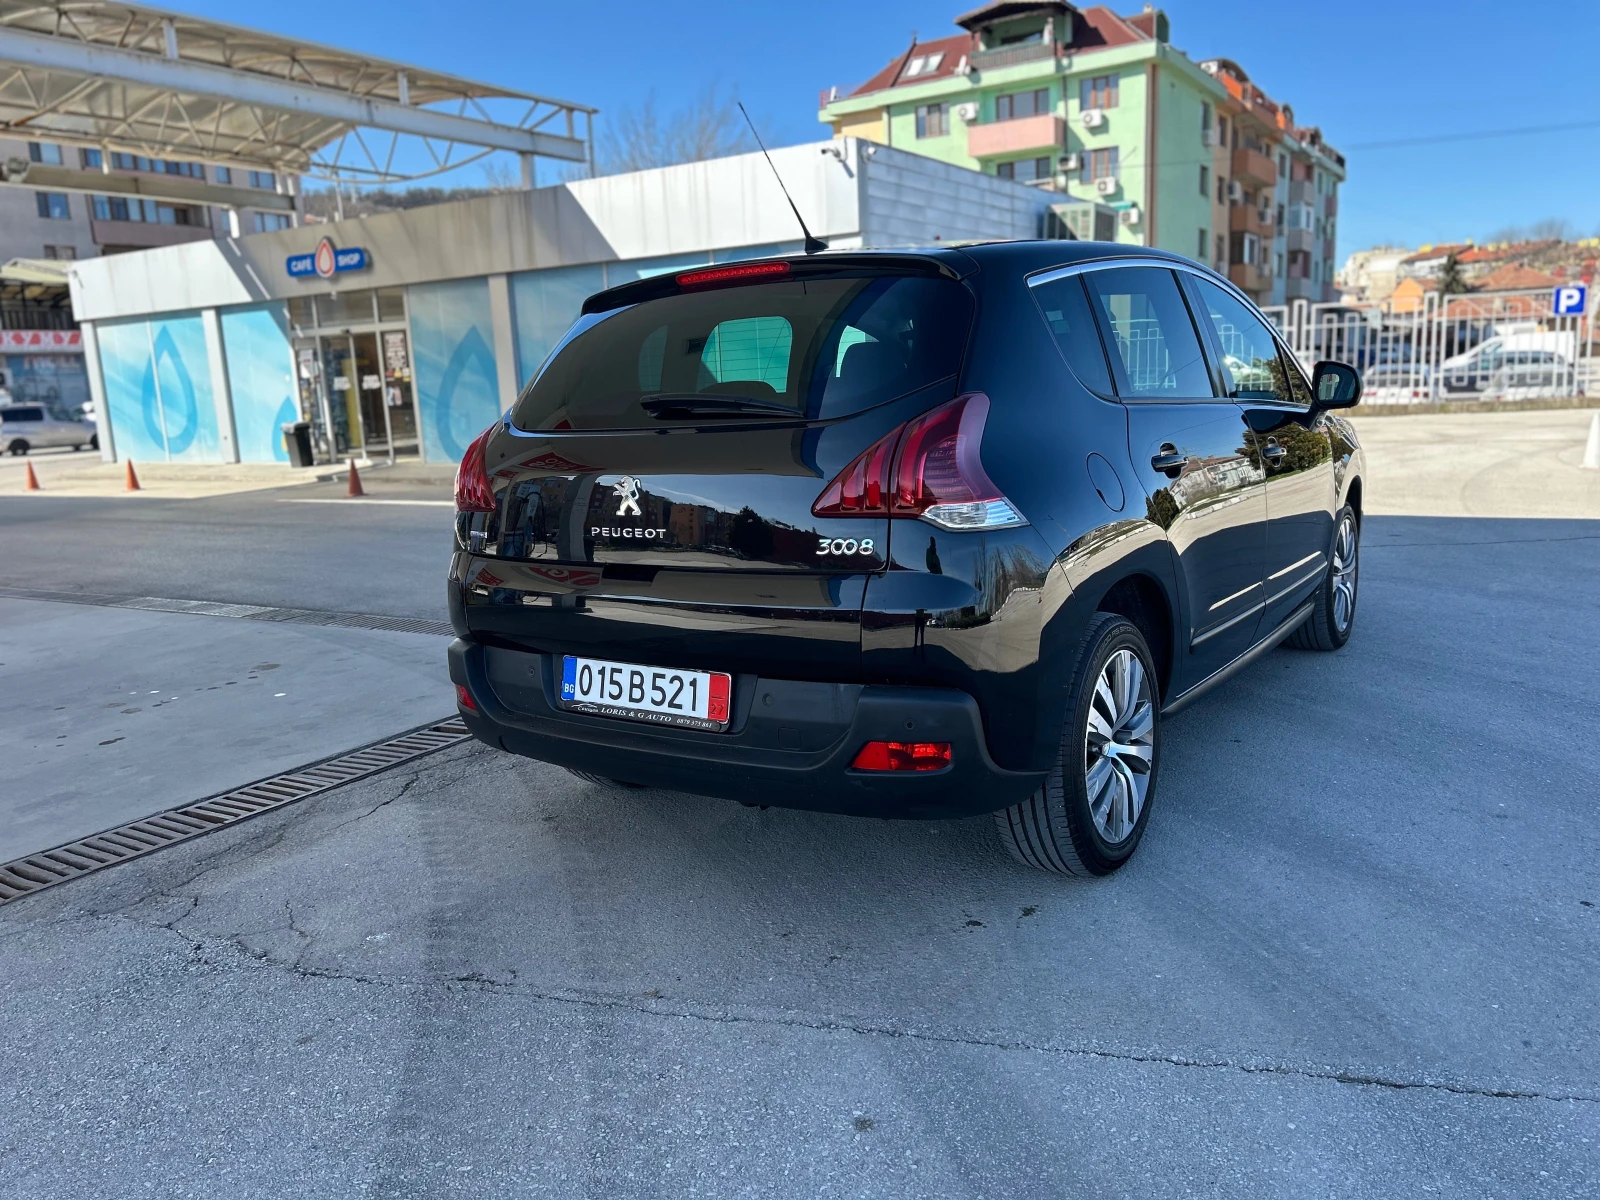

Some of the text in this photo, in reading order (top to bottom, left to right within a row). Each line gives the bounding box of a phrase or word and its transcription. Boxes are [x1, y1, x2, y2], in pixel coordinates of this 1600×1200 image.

[337, 252, 361, 267] SHOP
[1558, 288, 1581, 313] P
[591, 526, 667, 539] PEUGEOT
[815, 538, 874, 556] 3008
[564, 683, 575, 694] BG
[601, 707, 627, 717] LORIS
[637, 712, 645, 720] G
[646, 713, 672, 722] AUTO
[710, 703, 724, 716] 27
